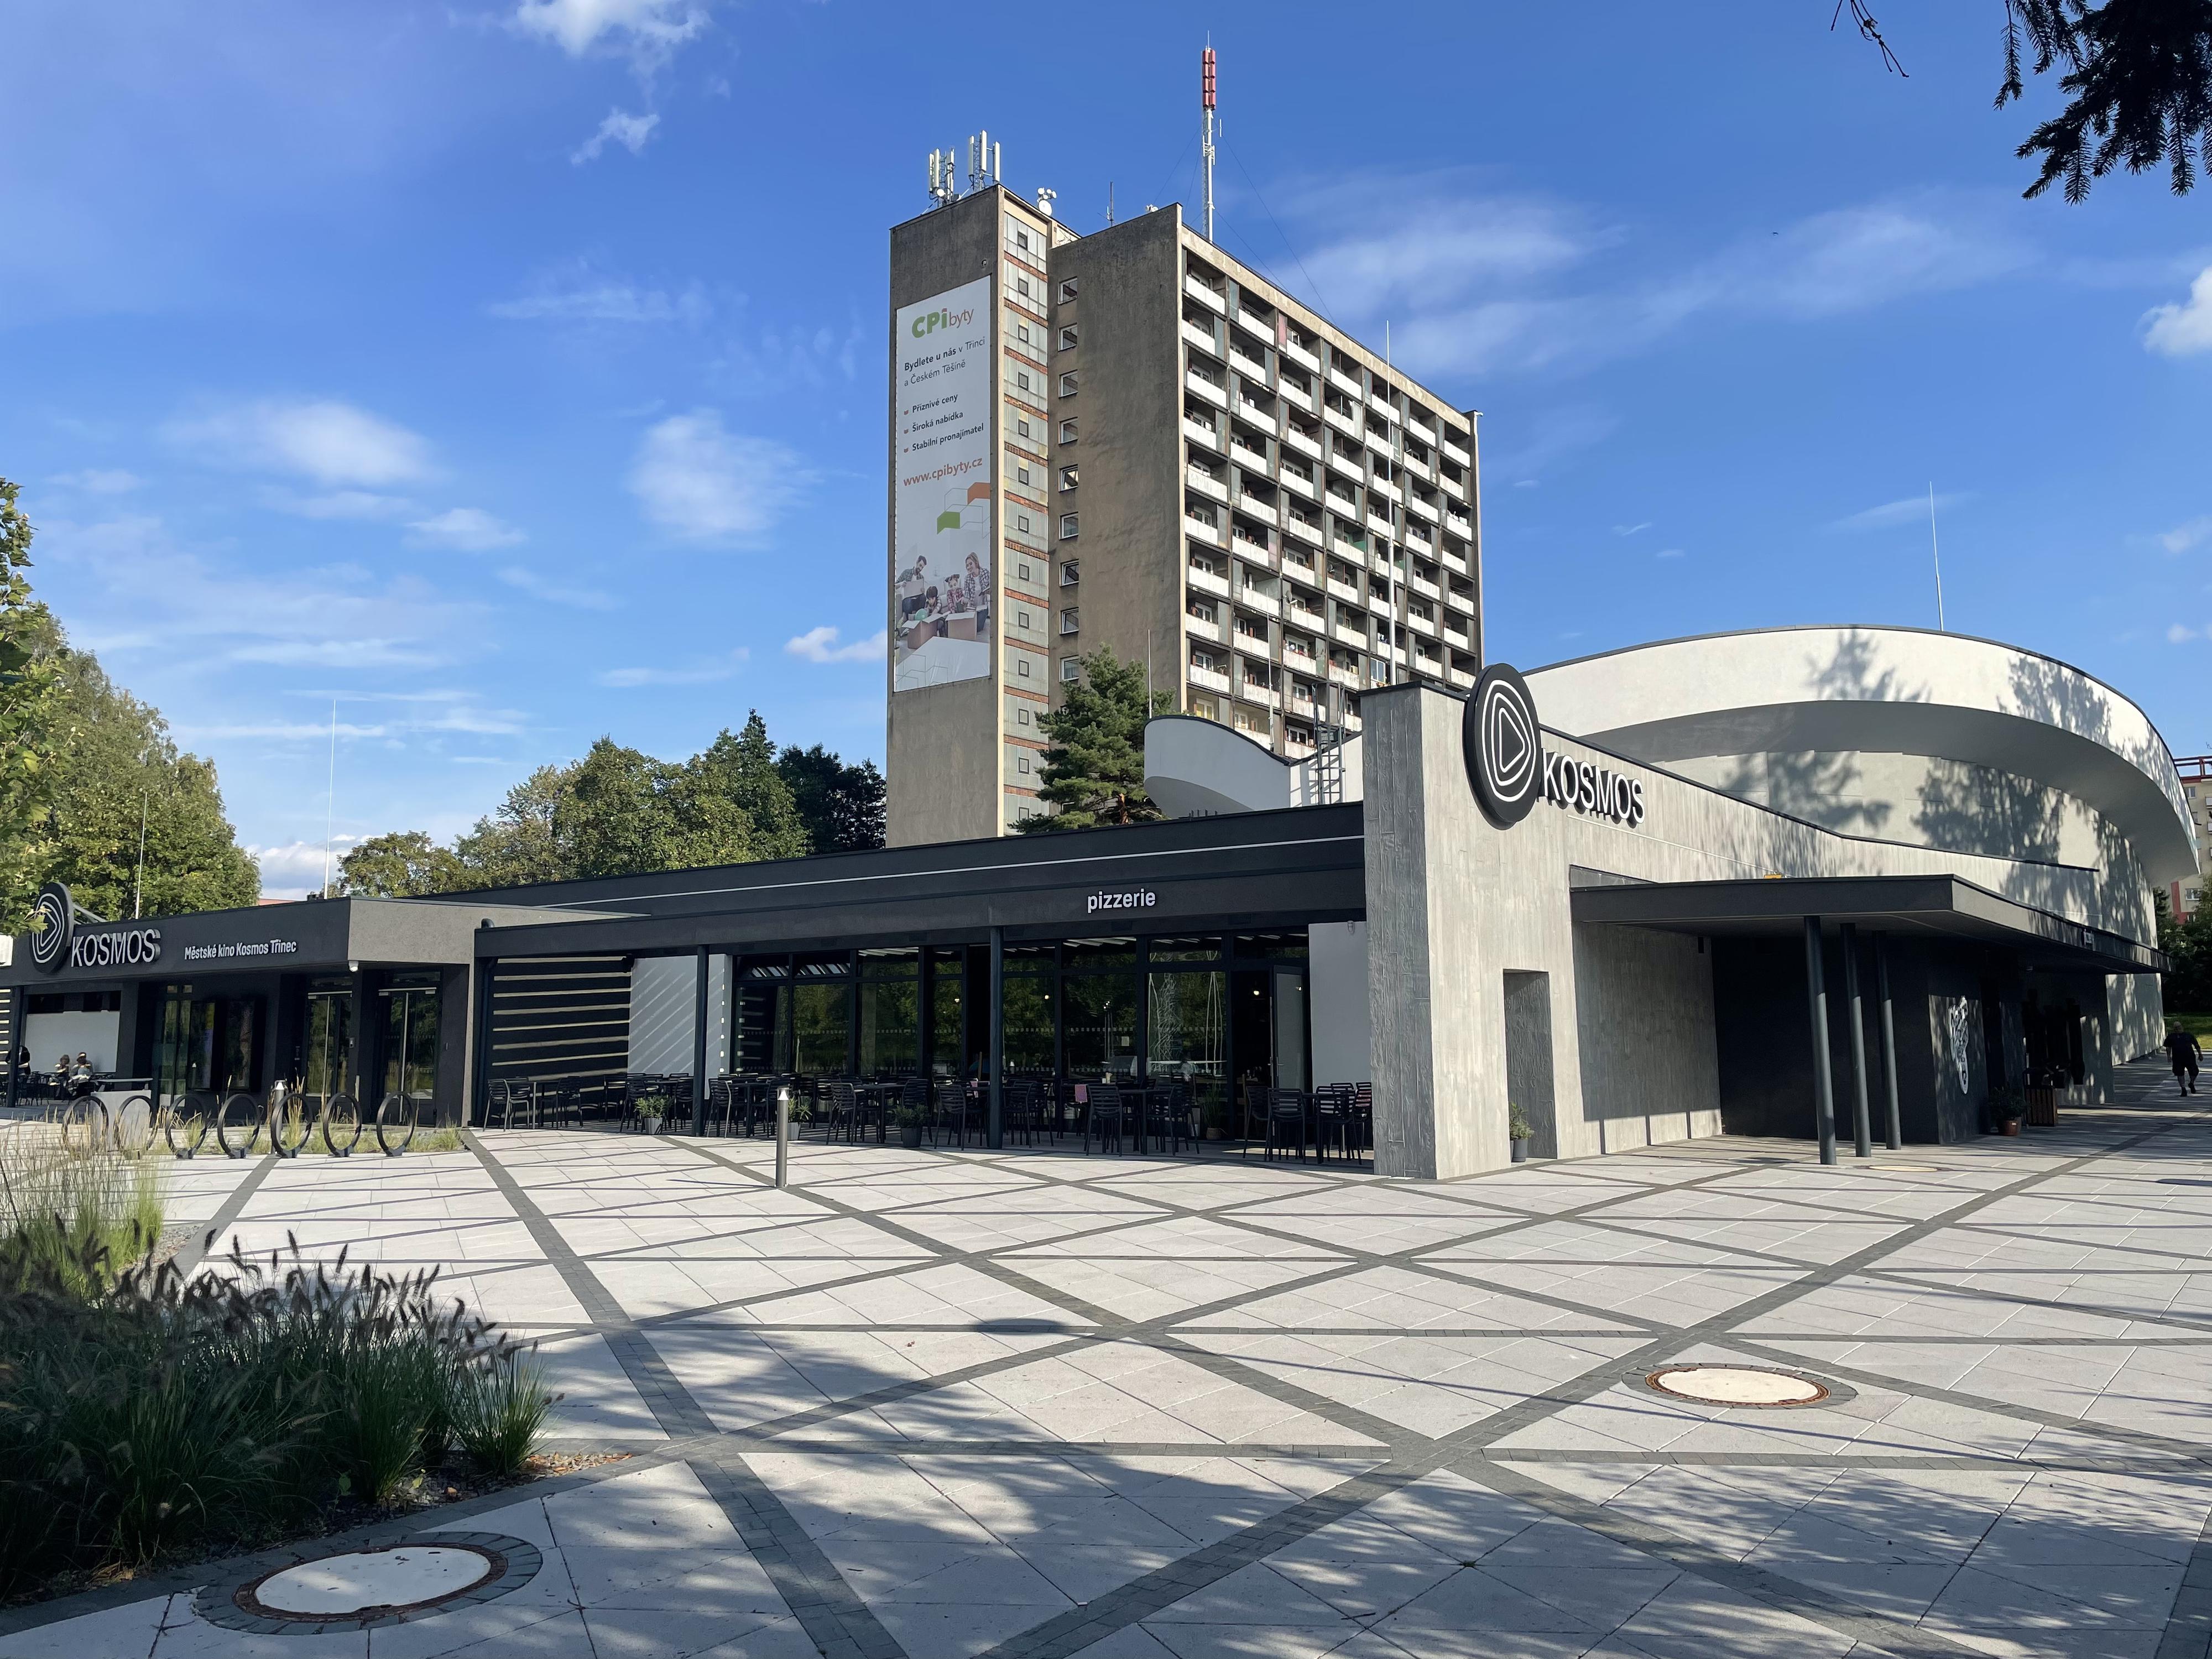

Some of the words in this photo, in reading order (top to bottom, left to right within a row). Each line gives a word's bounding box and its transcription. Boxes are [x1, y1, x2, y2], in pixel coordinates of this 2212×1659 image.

[904, 356, 933, 372] Bydlete
[943, 347, 956, 358] nás
[965, 336, 985, 350] Třinci
[910, 369, 940, 384] Českém
[942, 359, 966, 374] Těšíně
[912, 399, 940, 413] Příznivé
[942, 394, 958, 404] ceny
[912, 419, 933, 432] Široká
[936, 411, 963, 425] nabídka
[912, 436, 937, 451] Stabilní
[940, 422, 984, 445] pronajímatel
[903, 458, 983, 486] www.cpibyty.cz
[1541, 747, 1645, 823] KOSMOS
[1088, 888, 1156, 914] pizzerie
[71, 928, 158, 967] KOSMOS
[185, 944, 217, 960] Městské
[217, 943, 235, 957] kino
[236, 942, 269, 956] Kosmos
[270, 939, 297, 954] Třinec
